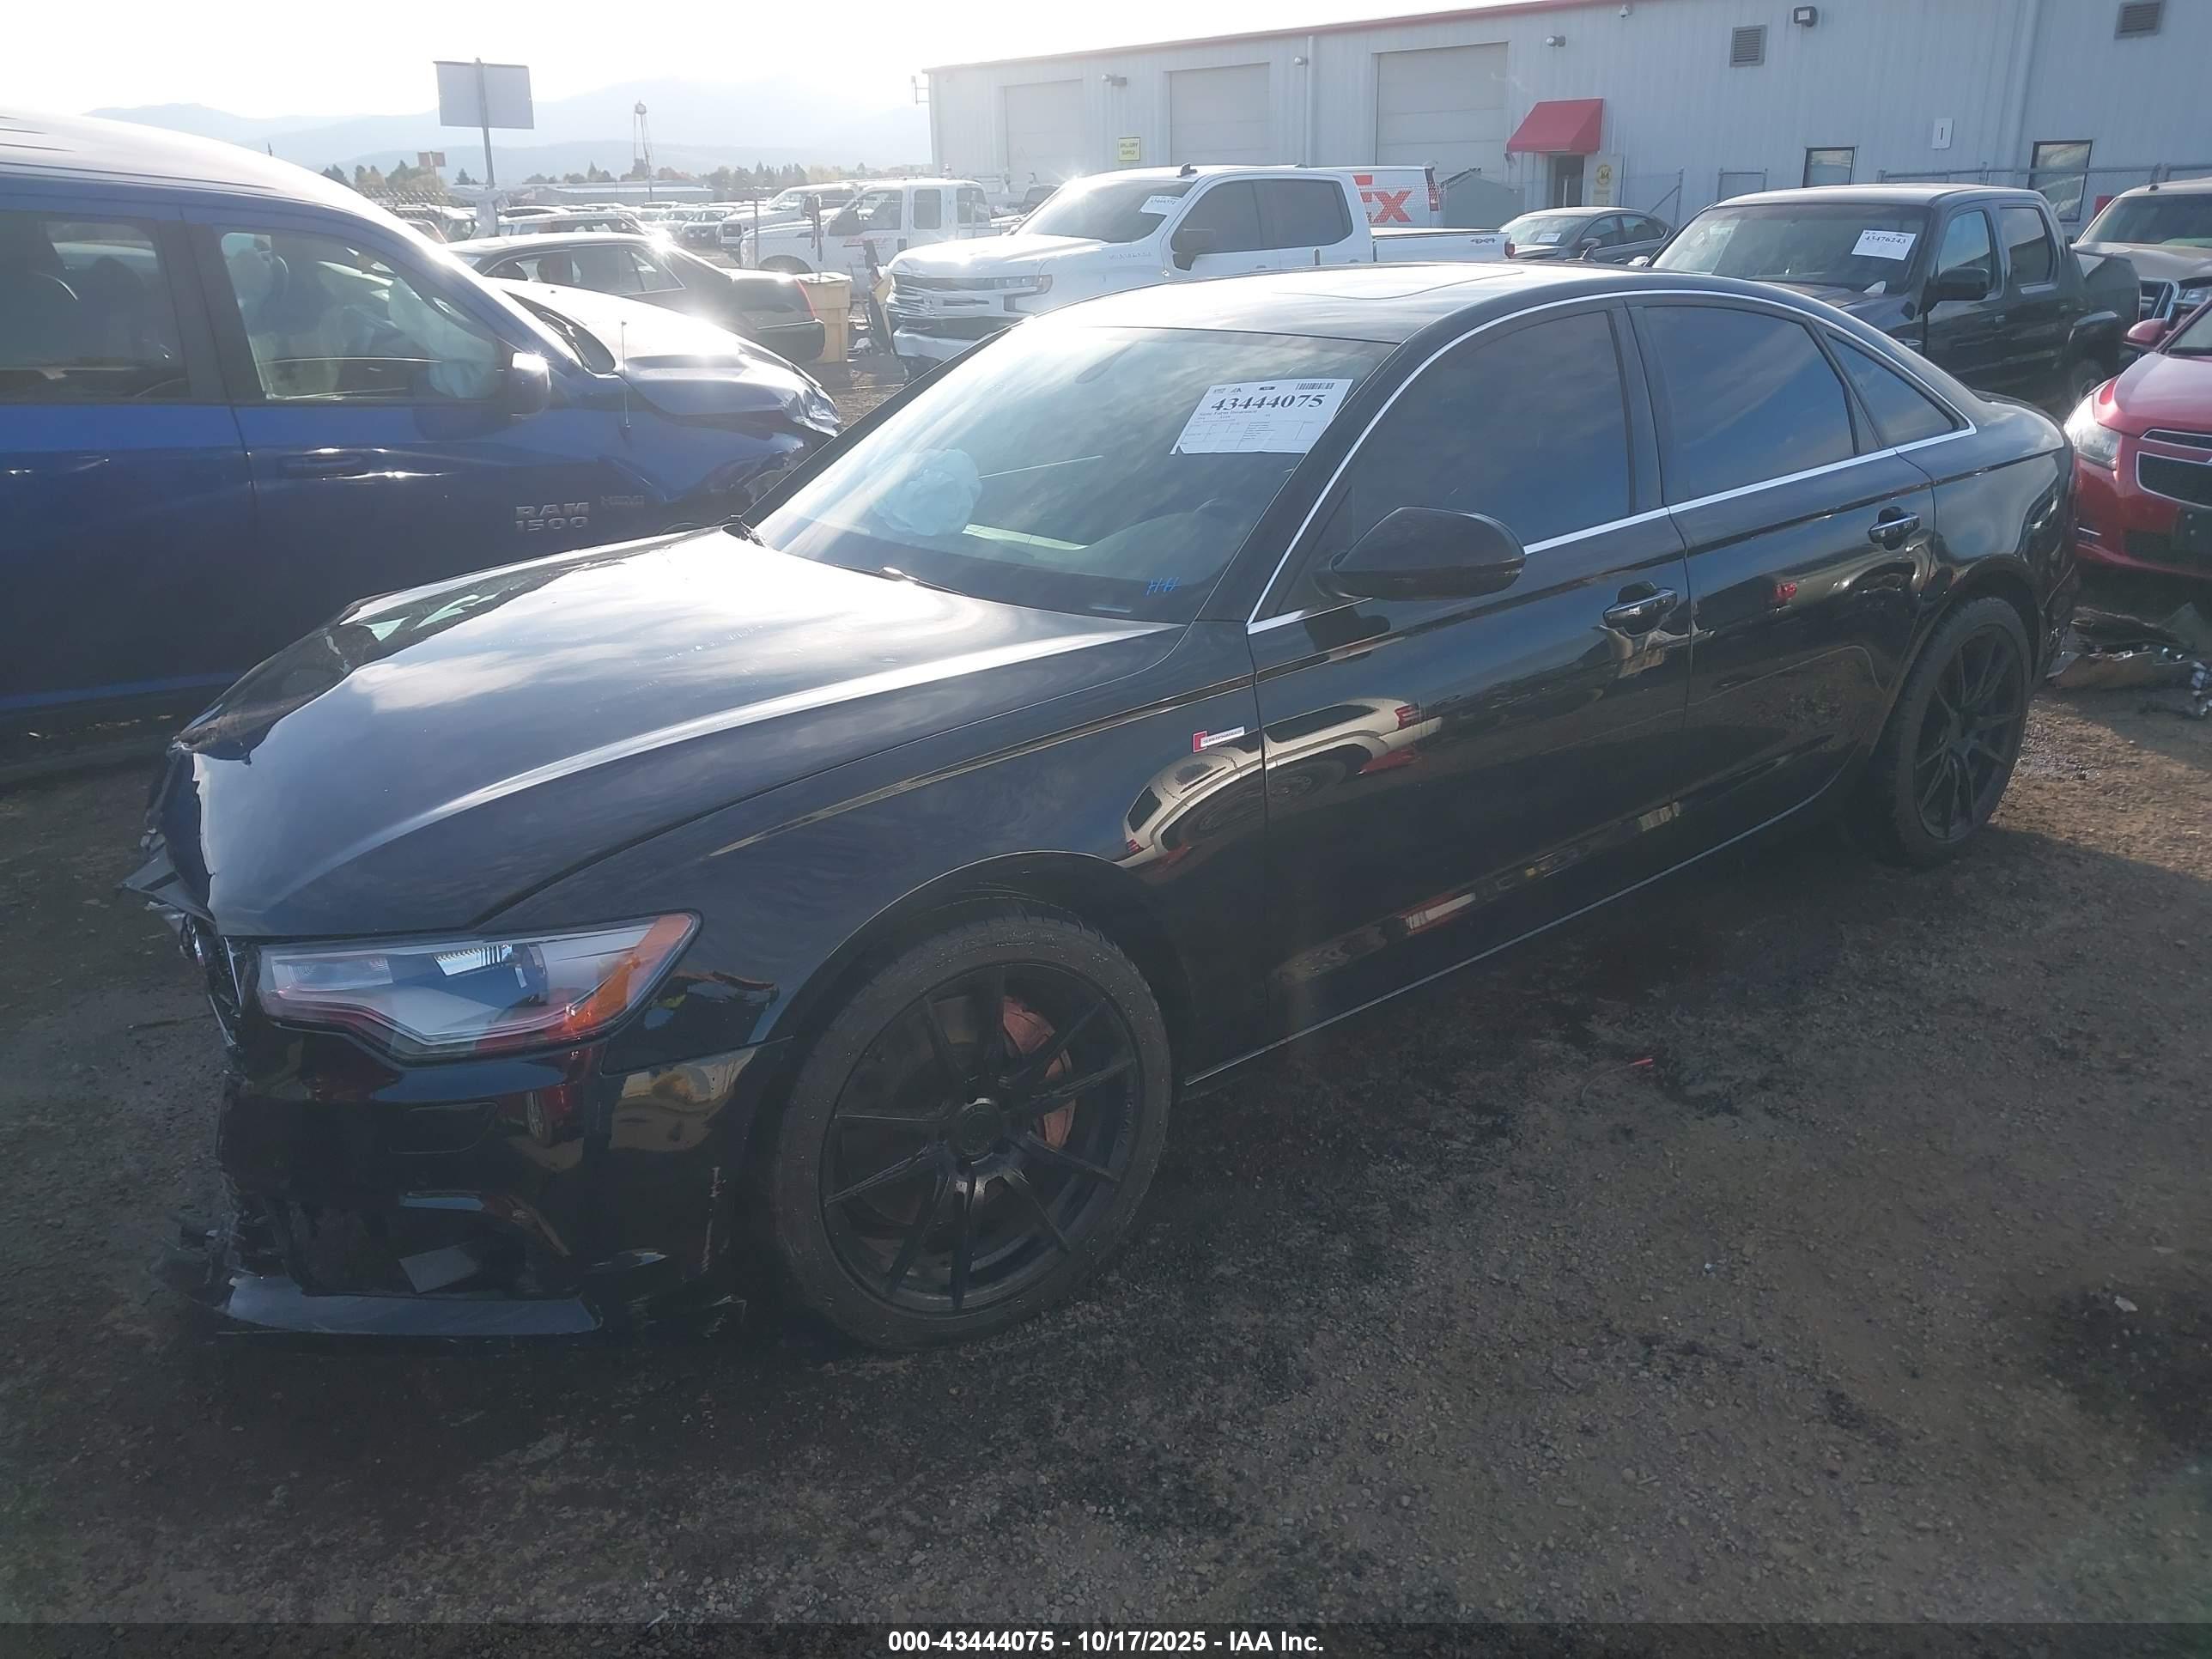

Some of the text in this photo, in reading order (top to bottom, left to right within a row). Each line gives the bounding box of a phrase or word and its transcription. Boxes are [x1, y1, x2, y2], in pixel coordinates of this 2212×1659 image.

[1211, 394, 1326, 411] 43444075
[515, 501, 591, 516] RAM
[515, 516, 589, 532] 1500
